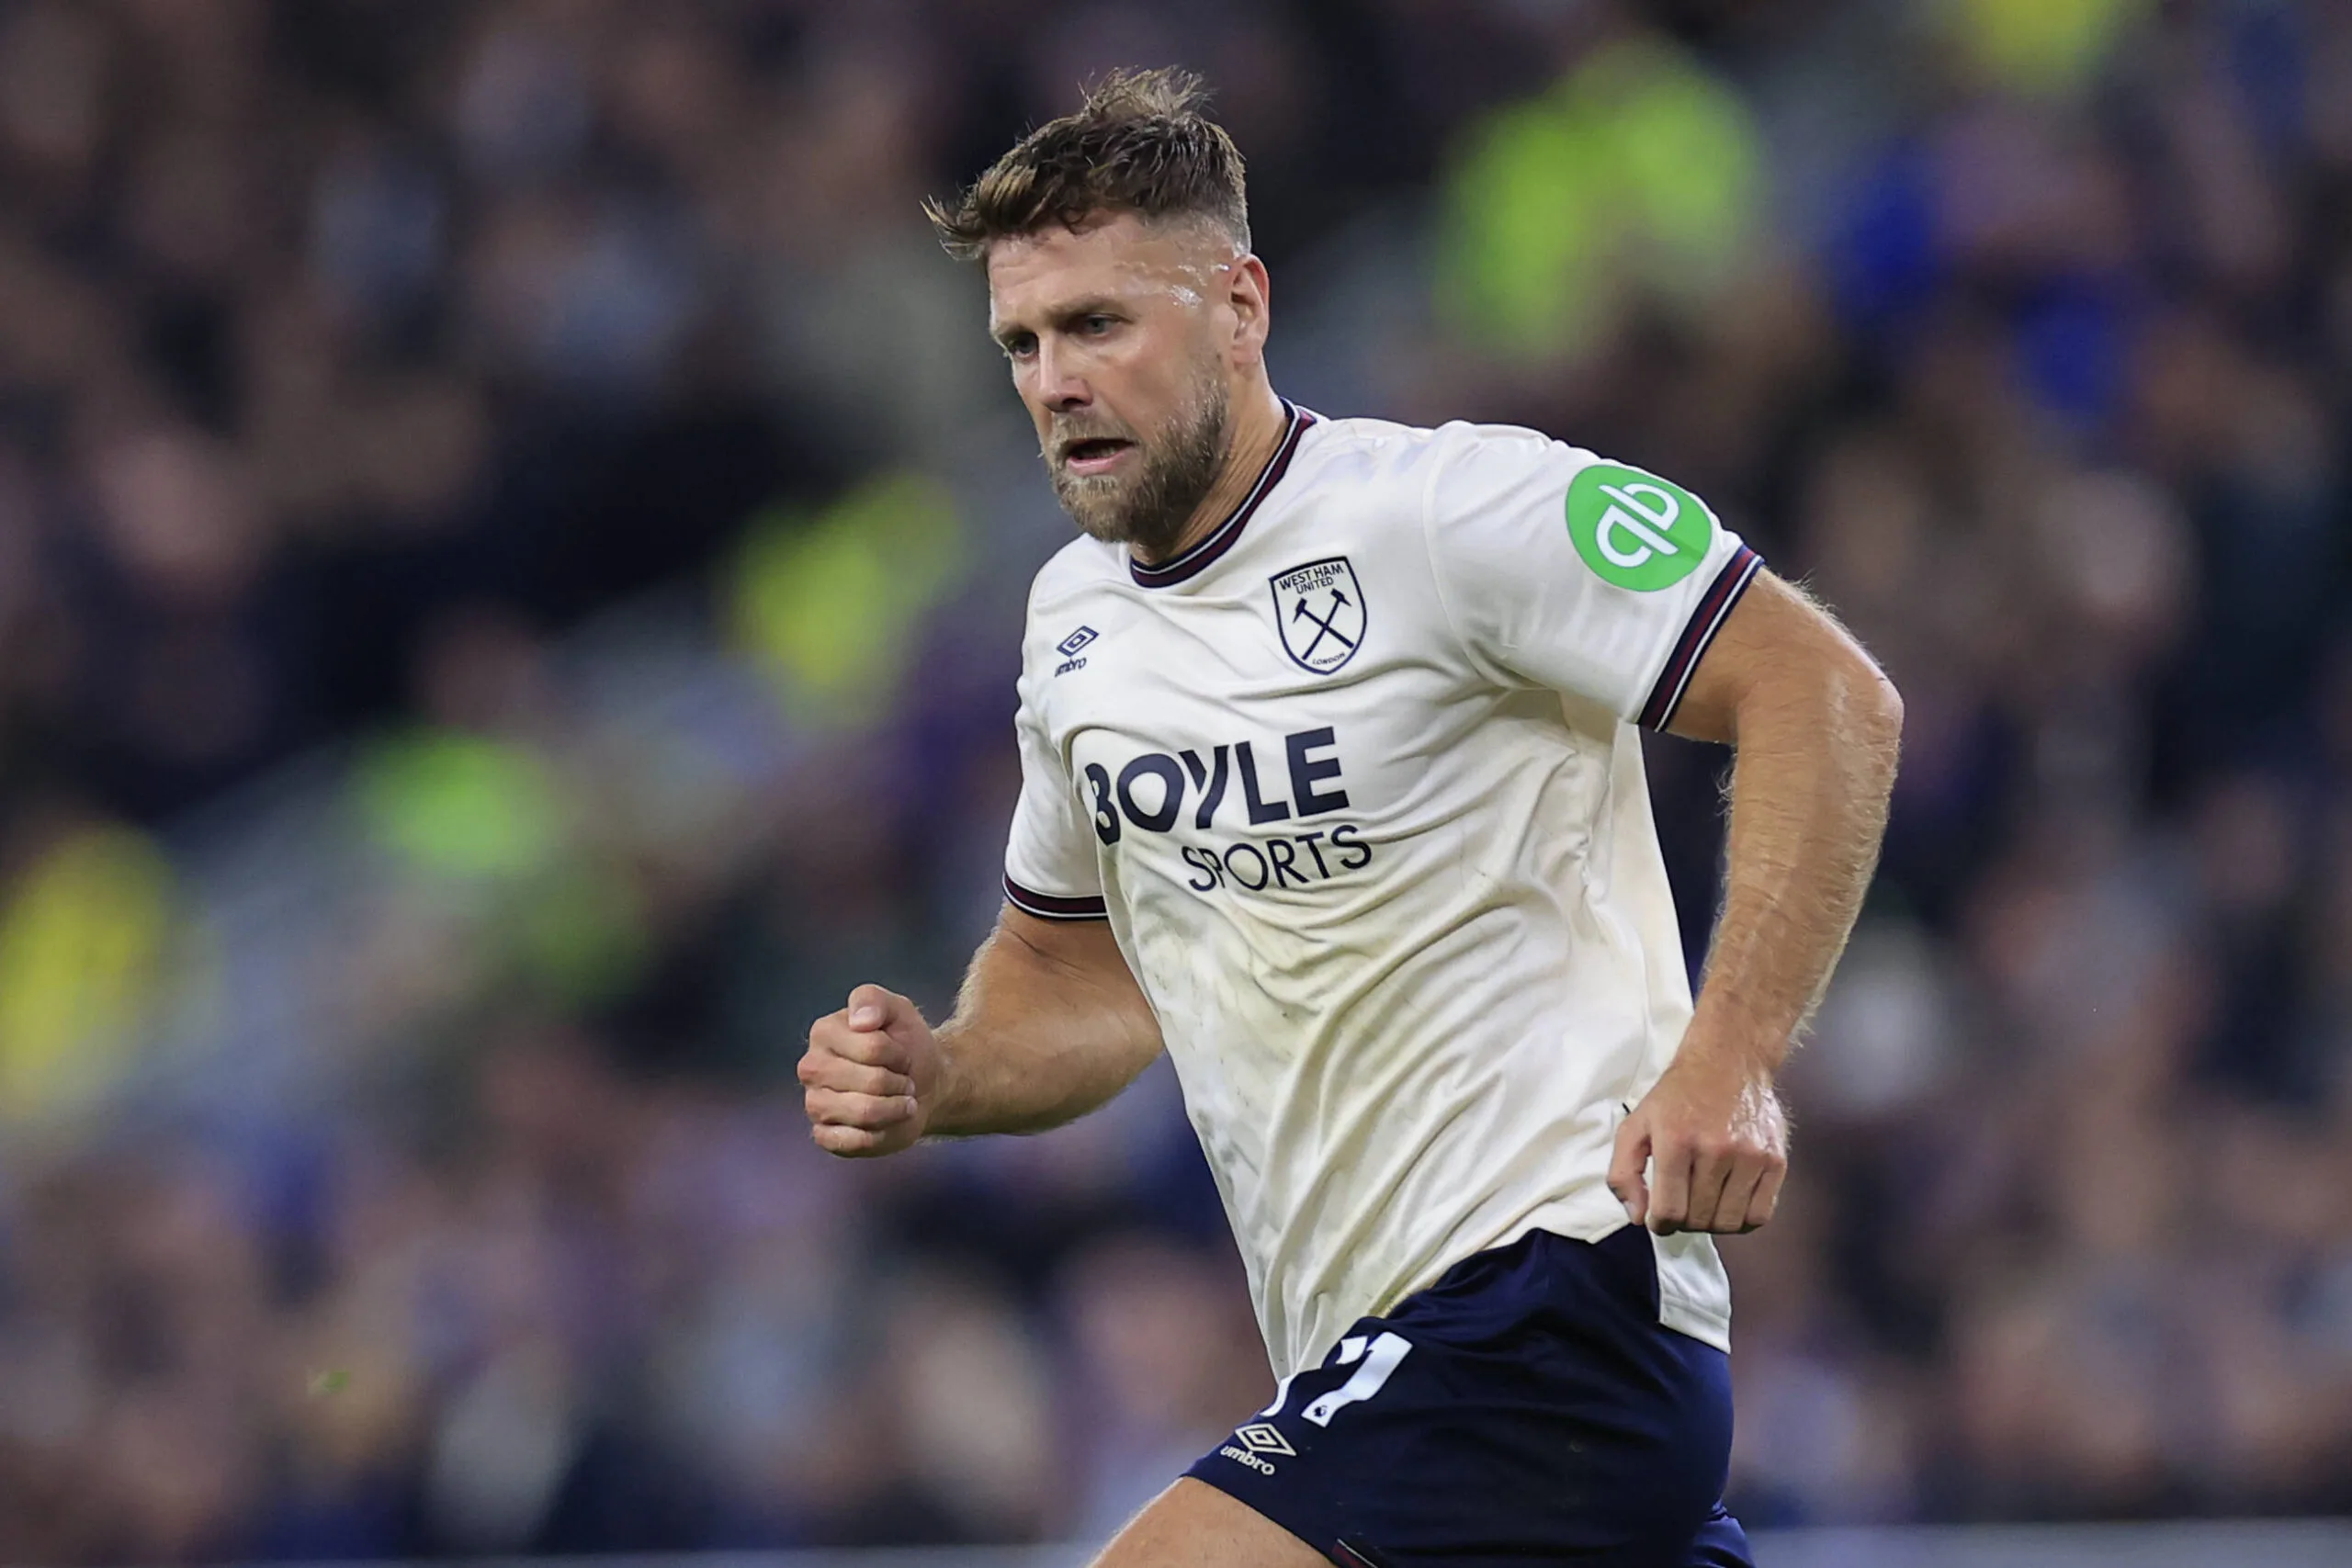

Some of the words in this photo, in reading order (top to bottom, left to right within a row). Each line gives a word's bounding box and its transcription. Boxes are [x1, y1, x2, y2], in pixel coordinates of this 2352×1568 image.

[1279, 569, 1312, 591] WEST
[1313, 563, 1344, 579] HAM
[1295, 576, 1334, 594] UNITED
[1312, 651, 1346, 666] LONDON
[1085, 727, 1350, 846] BOYLE
[1182, 825, 1372, 891] SPORTS
[1220, 1445, 1275, 1475] umbro
